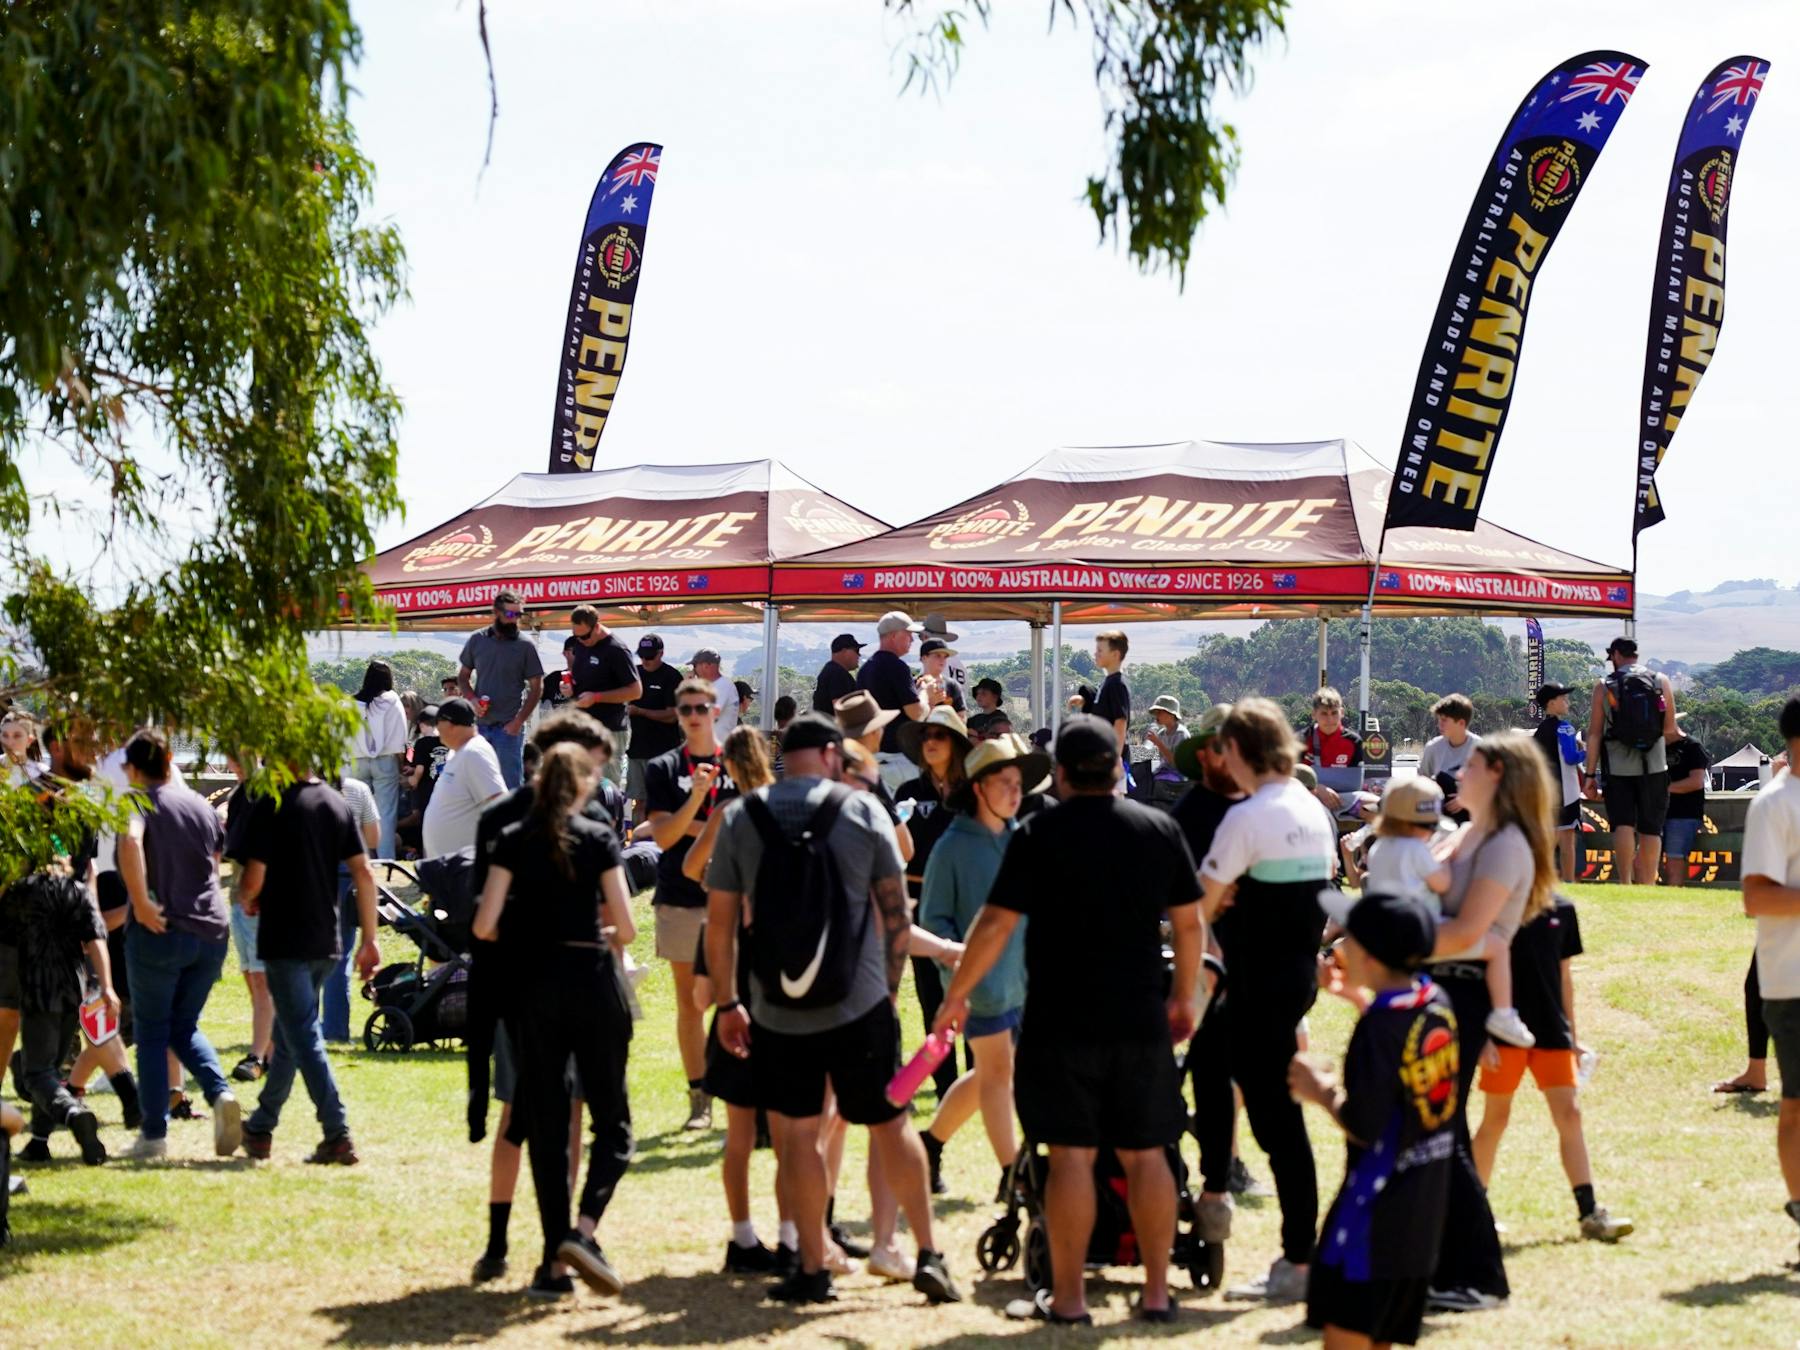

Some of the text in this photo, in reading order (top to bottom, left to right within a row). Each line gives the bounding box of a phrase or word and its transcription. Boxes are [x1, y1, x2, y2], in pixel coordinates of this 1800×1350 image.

[1531, 139, 1576, 213] PENRITE
[1710, 150, 1732, 225] PENRITE
[606, 225, 629, 290] PENRITE
[1667, 168, 1694, 303] AUSTRALIAN
[570, 243, 595, 358] AUSTRALIAN
[1399, 147, 1523, 495] AUSTRALIAN MADE AND OWNED
[1421, 212, 1550, 510] PENRITE
[1657, 314, 1680, 375] MADE
[1646, 385, 1664, 427] AND
[559, 427, 573, 465] AND
[497, 511, 757, 560] PENRITE
[784, 515, 878, 540] PENRITE
[926, 519, 1036, 540] PENRITE
[1038, 494, 1337, 539] PENRITE
[402, 543, 498, 562] PENRITE
[573, 554, 638, 565] Class
[1131, 538, 1206, 552] Class
[1208, 537, 1243, 552] of
[1244, 539, 1292, 554] Oil
[416, 590, 453, 607] 100%
[549, 579, 600, 598] OWNED
[604, 576, 645, 594] SINCE
[648, 575, 680, 593] 1926
[874, 569, 1264, 591] PROUDLY 100% AUSTRALIAN OWNED SINCE 1926
[1408, 574, 1602, 602] 100% AUSTRALIAN OWNED
[1528, 637, 1539, 700] PENRITE
